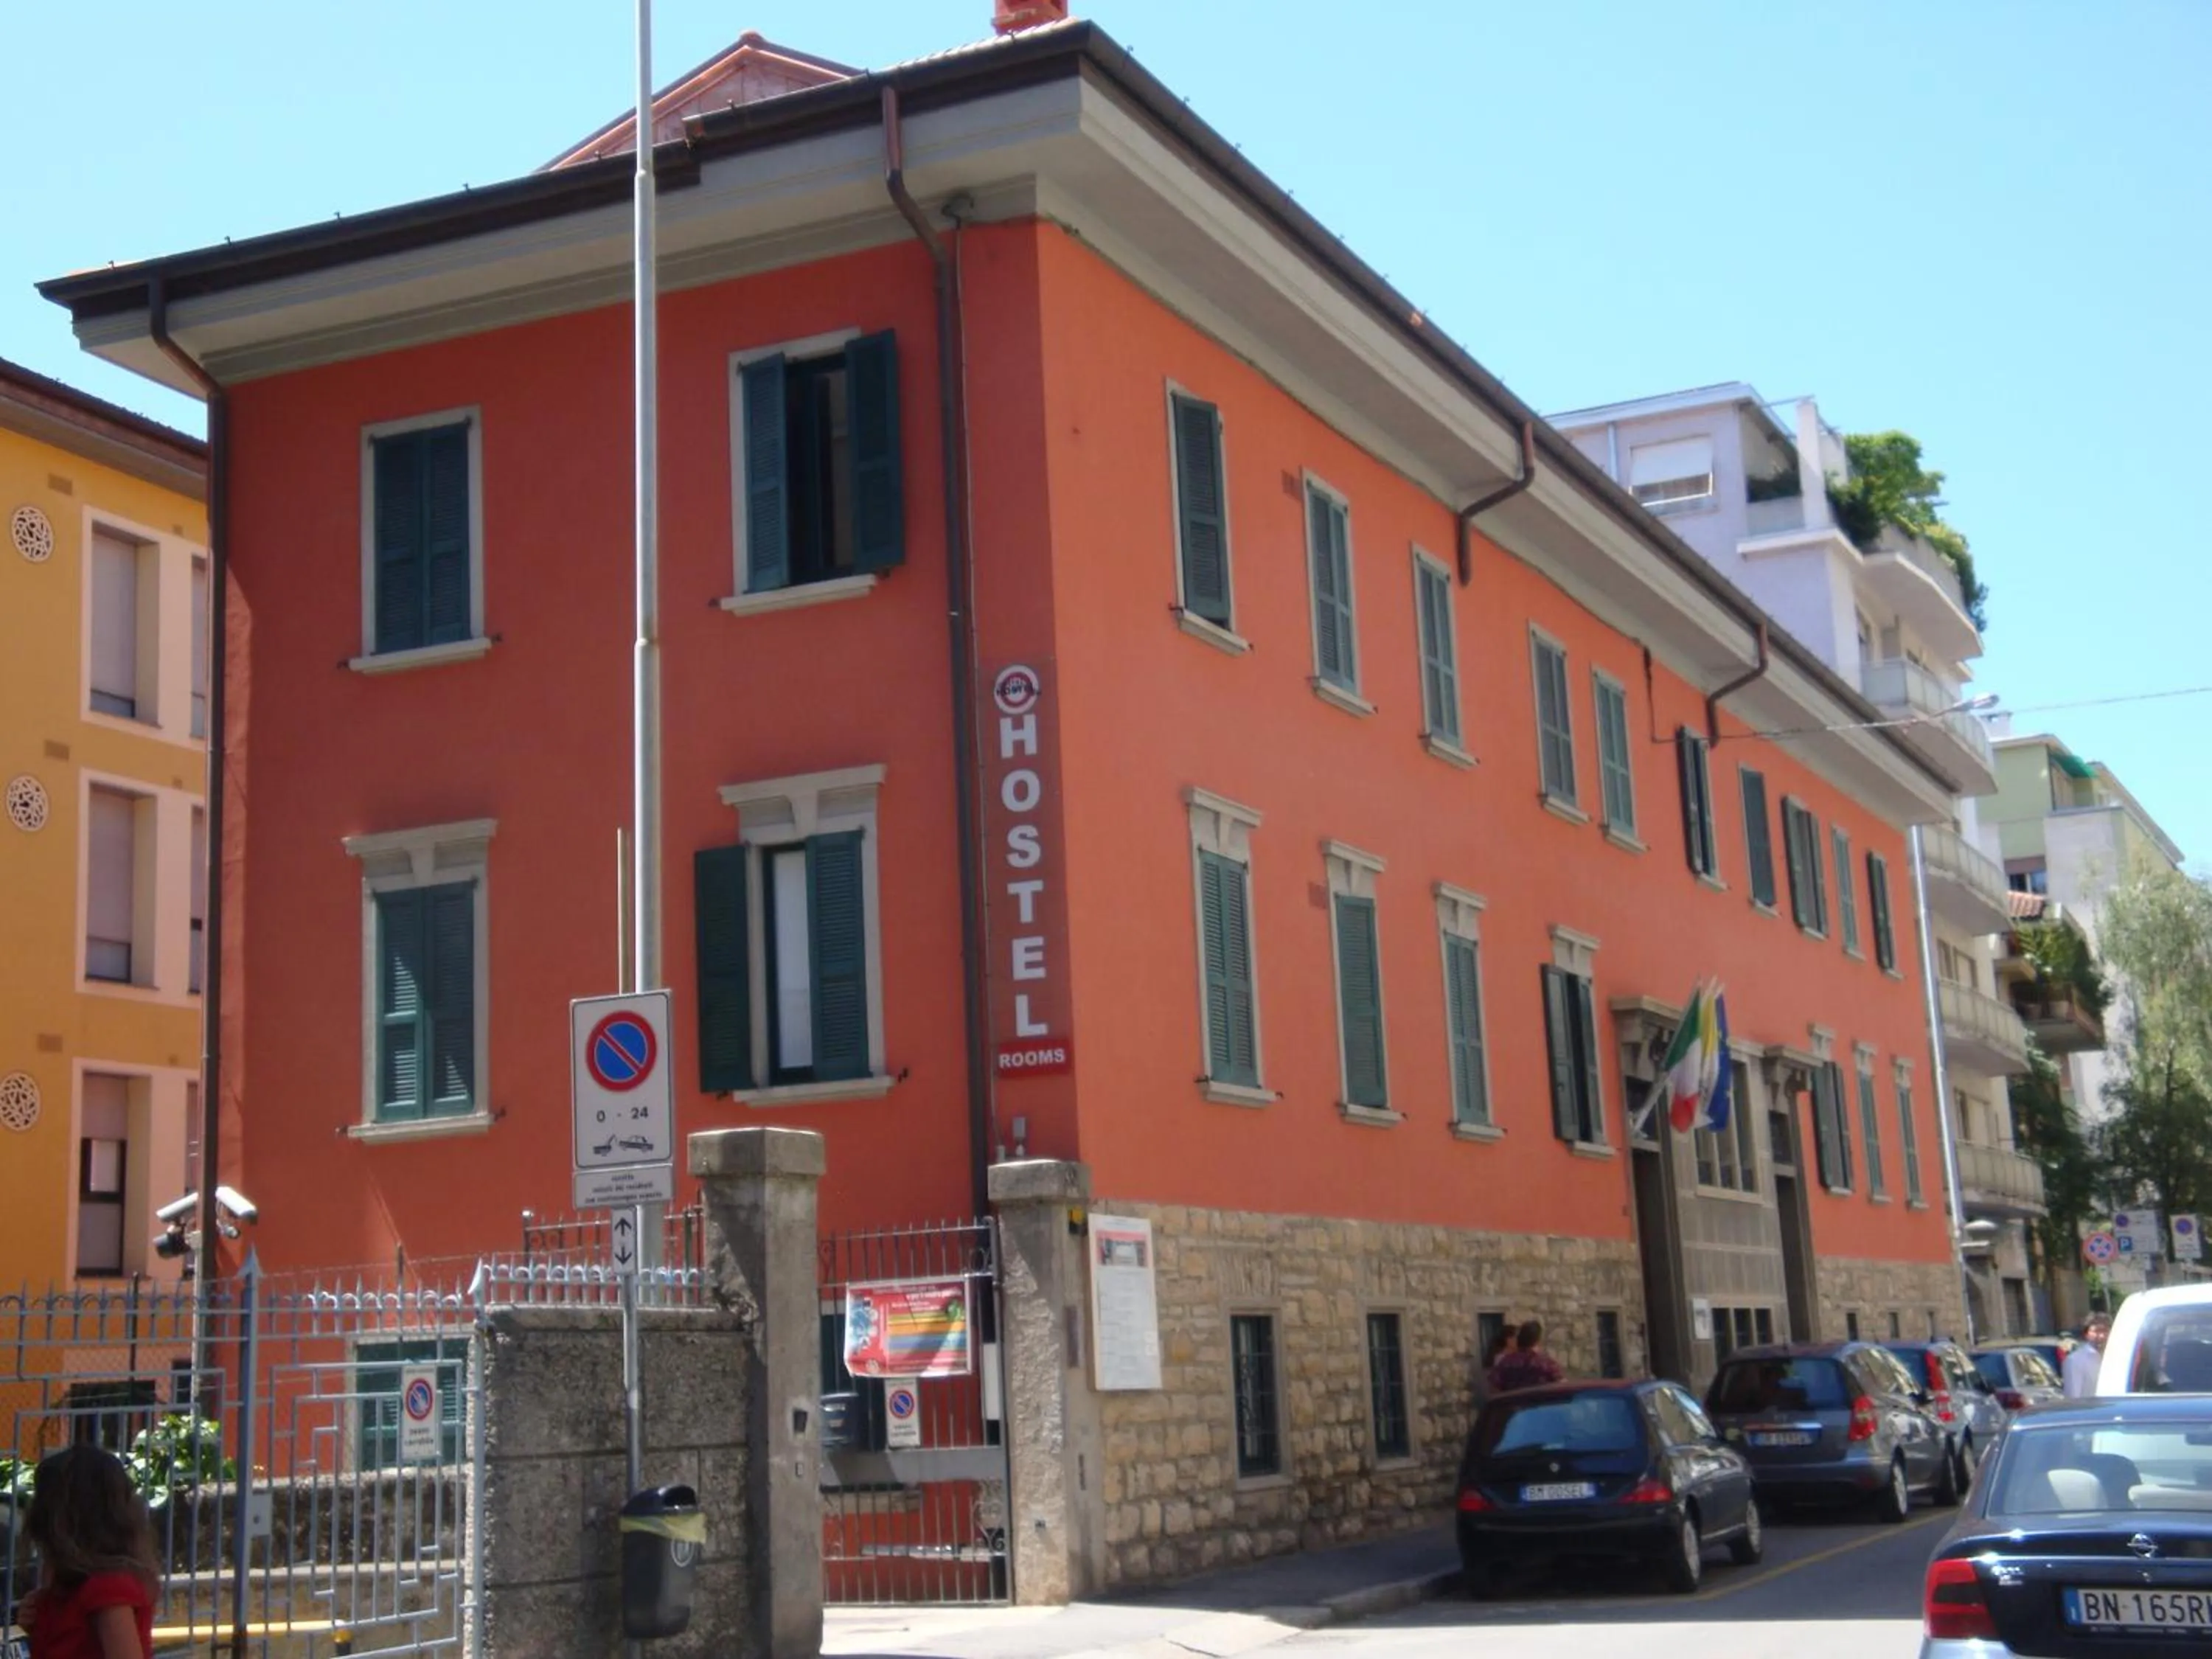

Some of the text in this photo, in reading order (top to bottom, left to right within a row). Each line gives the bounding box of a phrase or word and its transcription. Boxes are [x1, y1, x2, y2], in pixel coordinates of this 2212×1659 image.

[999, 714, 1048, 1037] HOSTEL
[998, 1047, 1065, 1068] ROOMS
[597, 1110, 606, 1123] 0
[630, 1106, 649, 1120] 24
[2084, 1593, 2121, 1621] BN
